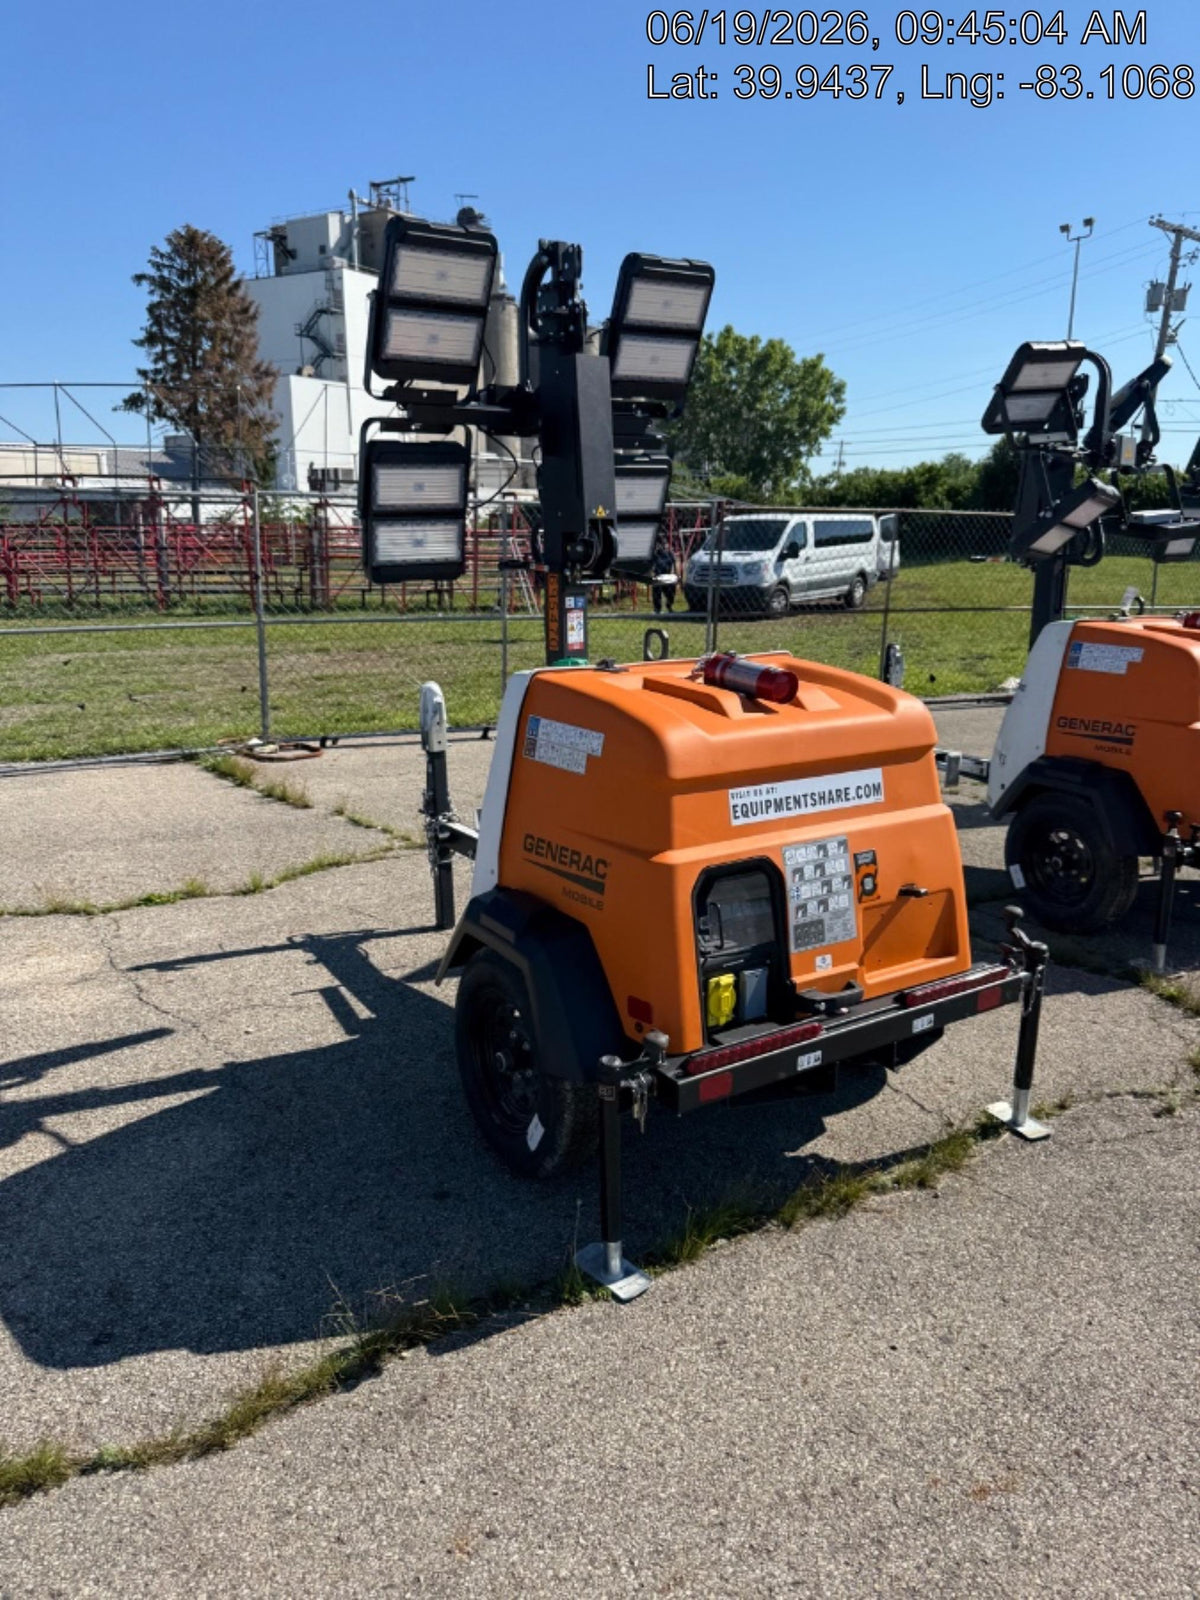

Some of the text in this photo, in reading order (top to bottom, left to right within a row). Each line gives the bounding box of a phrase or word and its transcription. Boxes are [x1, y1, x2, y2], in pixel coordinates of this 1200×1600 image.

[1056, 716, 1137, 737] GENERAC
[732, 781, 883, 820] EQUIPMENTSHARE.COM
[523, 833, 608, 880] GENERAC
[561, 886, 605, 911] MOBILE
